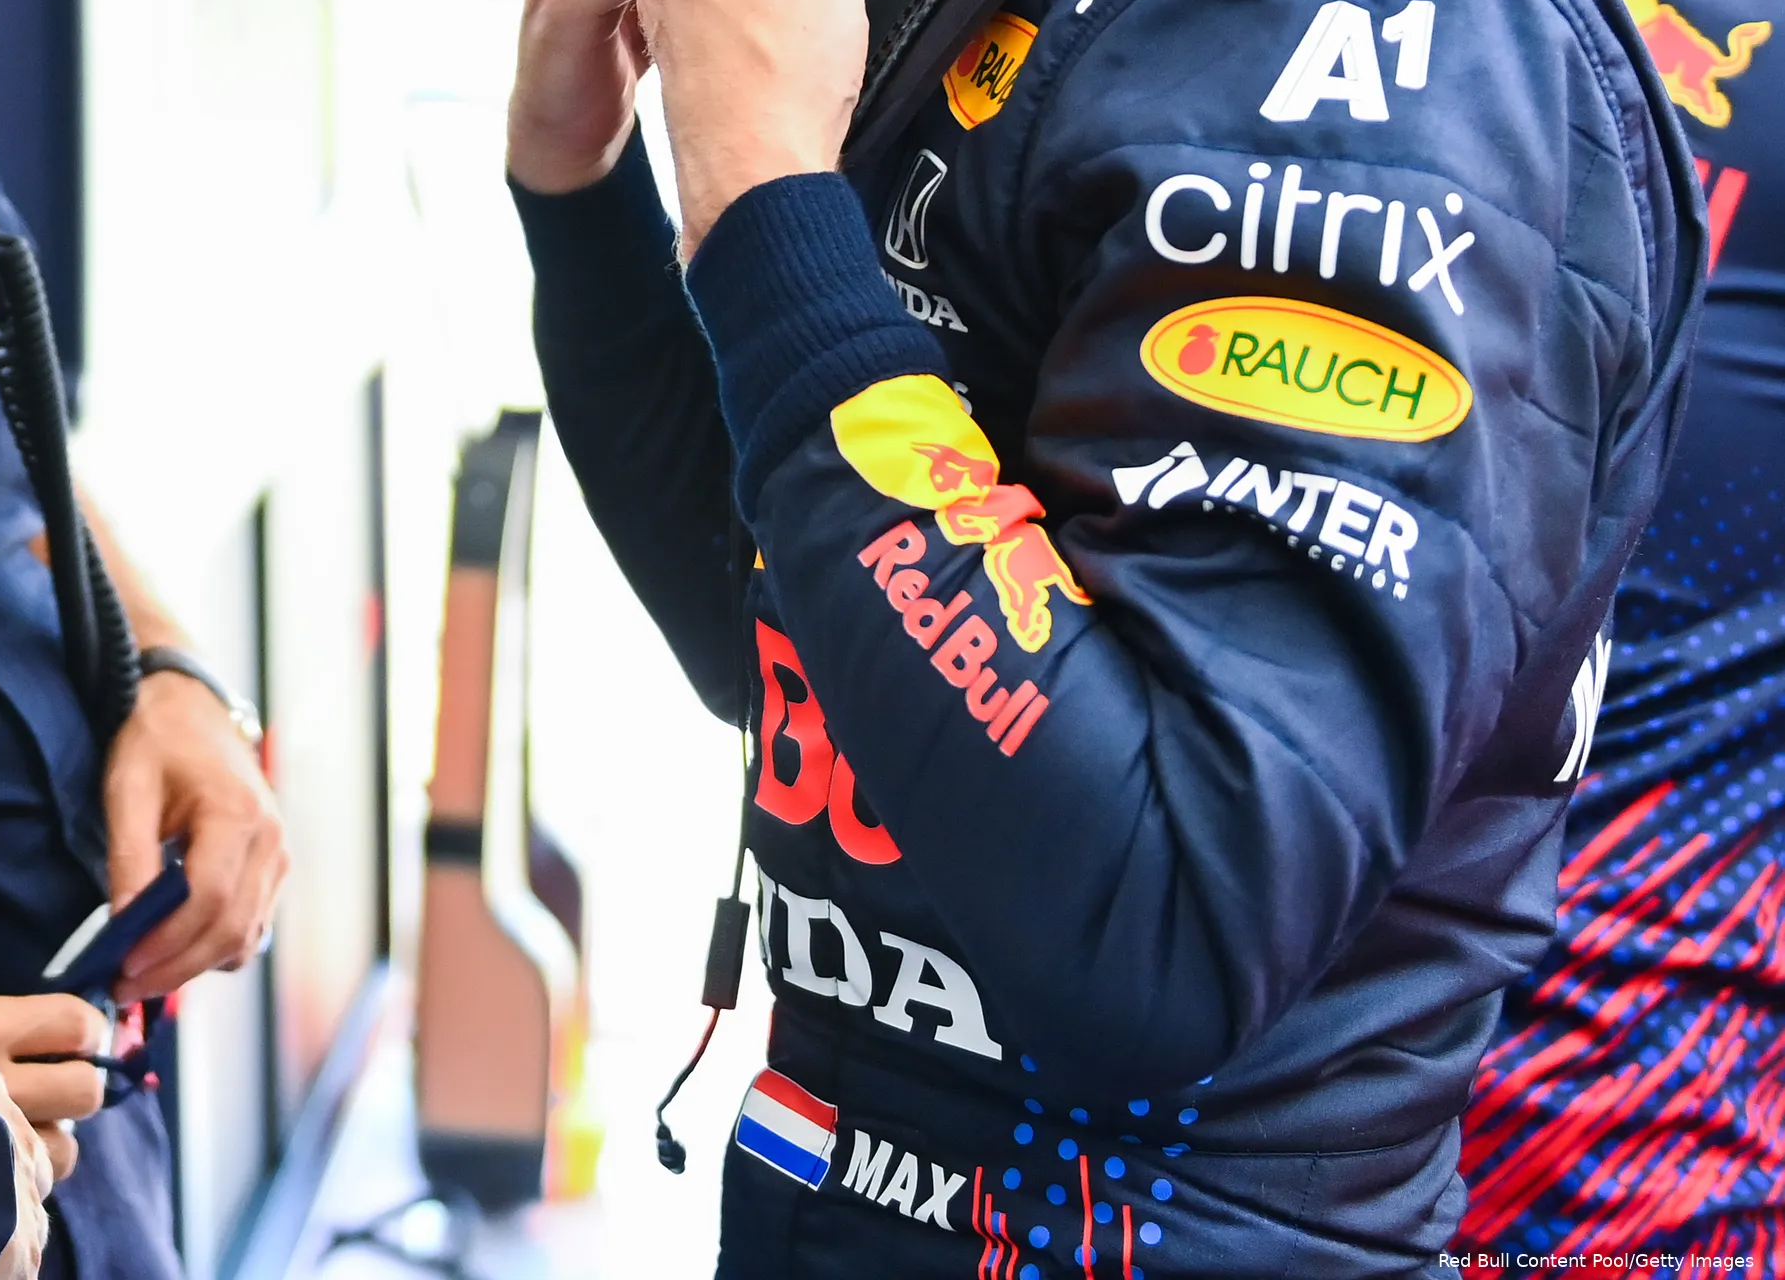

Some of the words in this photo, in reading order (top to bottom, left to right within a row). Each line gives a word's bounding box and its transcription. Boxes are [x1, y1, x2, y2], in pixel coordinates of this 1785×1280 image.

[1259, 0, 1436, 122] A1
[1145, 161, 1475, 316] citrix
[1221, 331, 1426, 420] RAUCH
[1206, 457, 1419, 580] INTER
[857, 520, 973, 650] Red
[930, 614, 1050, 758] Bull
[842, 1129, 967, 1232] MAX
